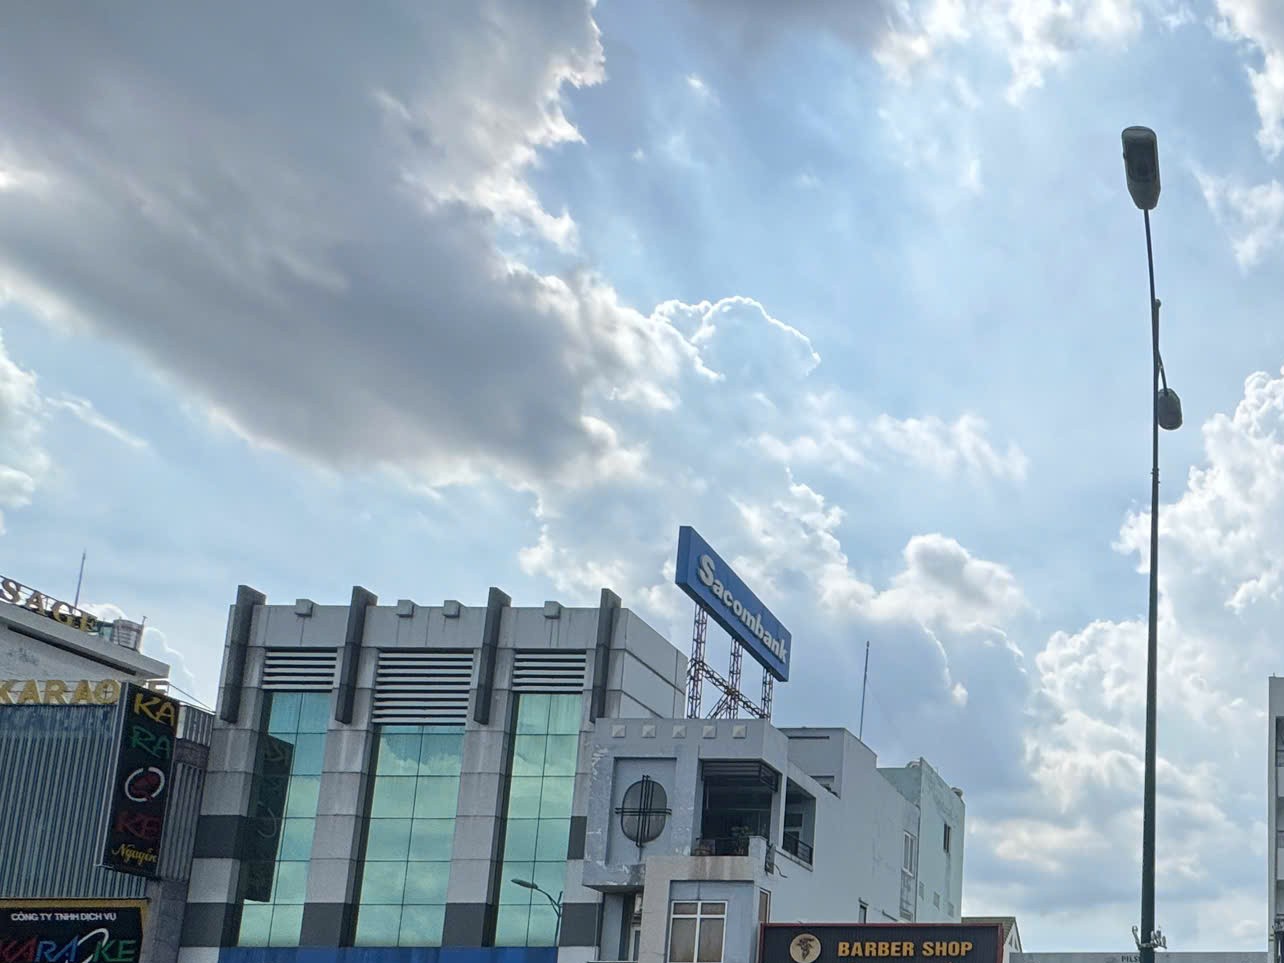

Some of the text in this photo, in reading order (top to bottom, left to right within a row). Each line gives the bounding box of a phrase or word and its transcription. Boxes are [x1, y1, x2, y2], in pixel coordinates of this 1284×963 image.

[698, 554, 788, 664] Sacombank
[11, 911, 38, 921] CÔNG
[40, 913, 52, 921] TY
[54, 913, 79, 921] TNHH
[838, 941, 973, 957] BARBER SHOP
